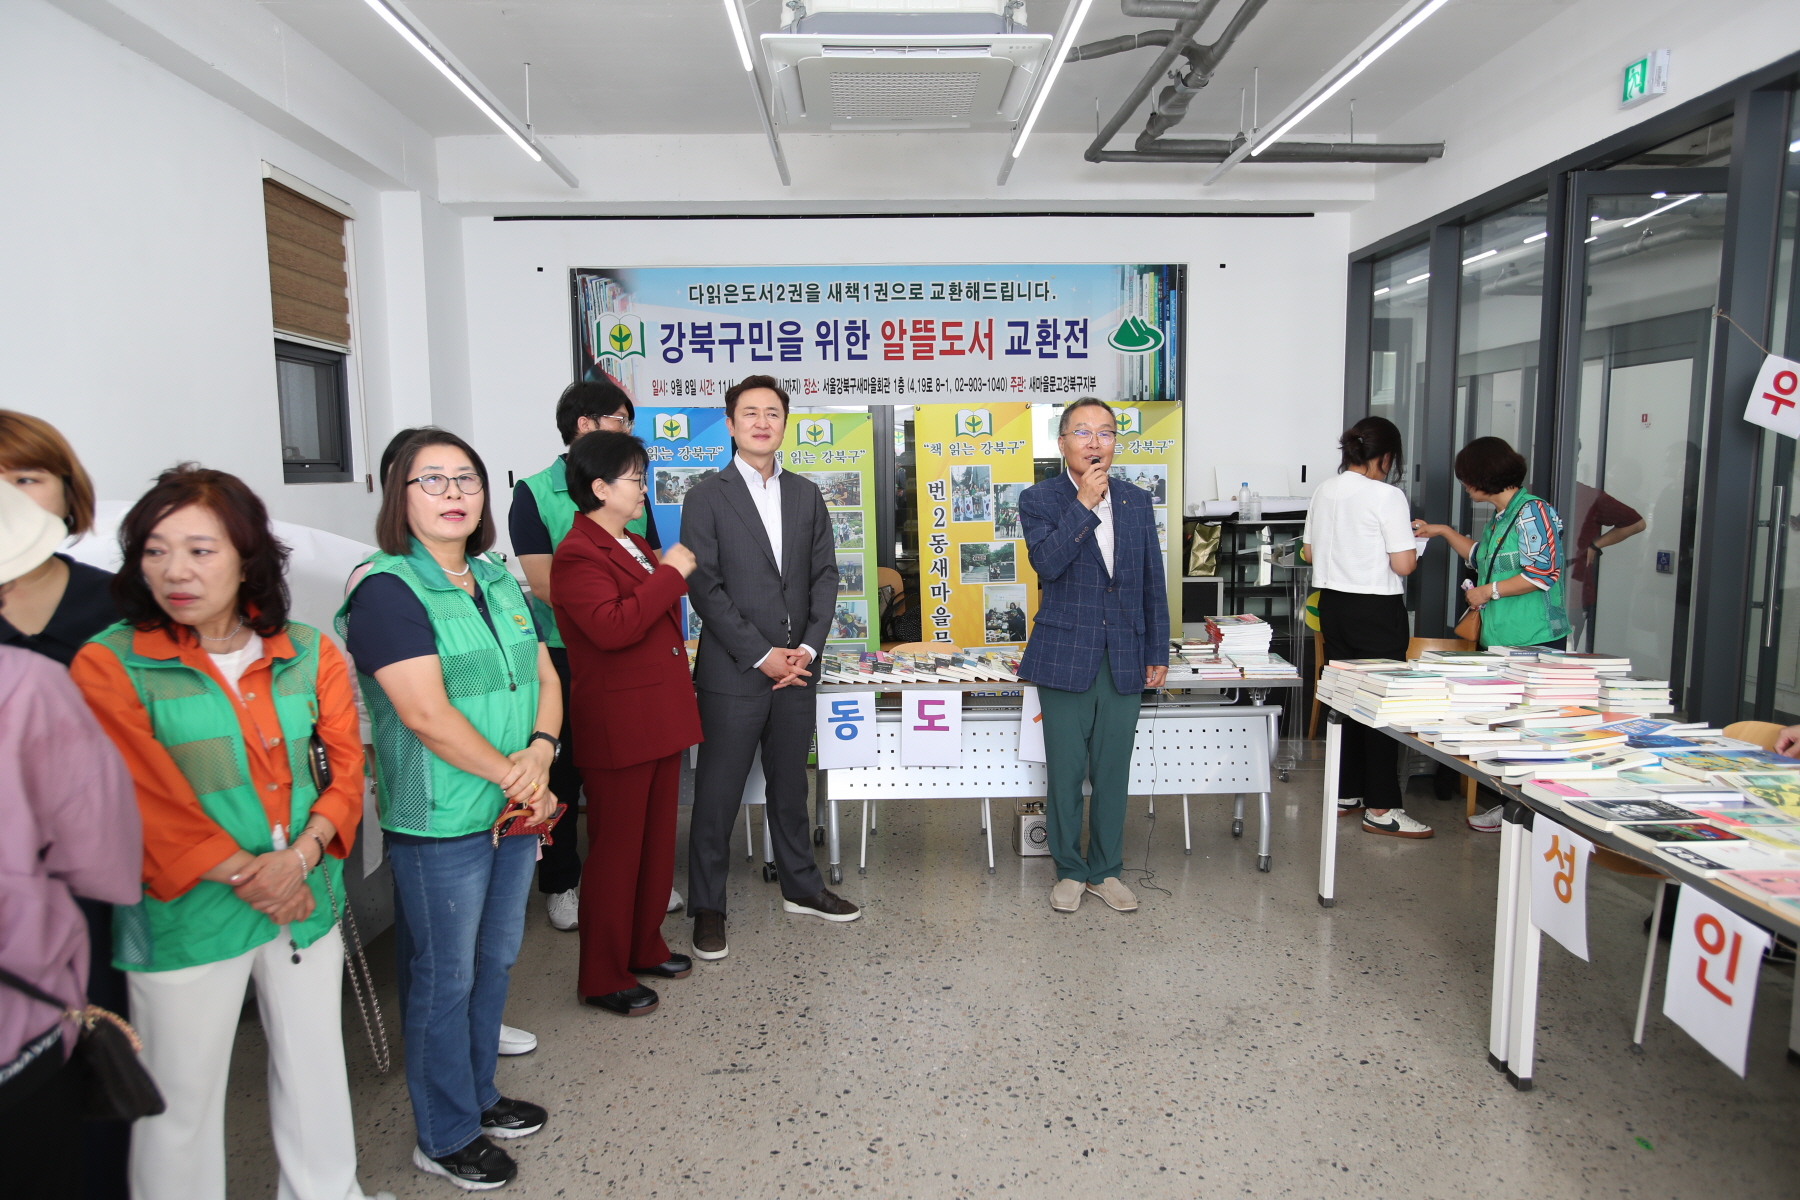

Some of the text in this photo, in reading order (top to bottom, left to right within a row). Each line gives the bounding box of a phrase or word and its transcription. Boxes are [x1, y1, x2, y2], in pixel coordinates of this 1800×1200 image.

[688, 280, 1057, 305] 다읽은도서2권을 새책1권으로 교환해드립니다.
[659, 317, 1089, 364] 강북구민을 위한 알뜰도서 교환전
[651, 379, 668, 396] 일시:
[670, 379, 682, 396] 9월
[684, 379, 697, 396] 8일
[699, 378, 715, 396] 시간:
[803, 377, 820, 395] 장소:
[822, 376, 891, 395] 서울강북구새마을회관
[893, 376, 905, 395] 1층
[935, 377, 952, 394] 8-1,
[954, 376, 1008, 393] 02-903-1040)
[1010, 375, 1026, 393] 주관:
[1028, 375, 1097, 393] 새마을문고강북구지부
[1761, 370, 1798, 416] 우
[646, 445, 725, 461] 읽는 강북구”
[790, 450, 816, 465] 읽는
[821, 449, 866, 465] 강북구”
[948, 441, 975, 457] 읽는
[980, 440, 1026, 456] 강북구”
[1128, 439, 1175, 455] 강북구”
[827, 700, 864, 741] 동
[913, 699, 950, 732] 도
[1543, 834, 1576, 904] 성
[1694, 912, 1743, 1007] 인
